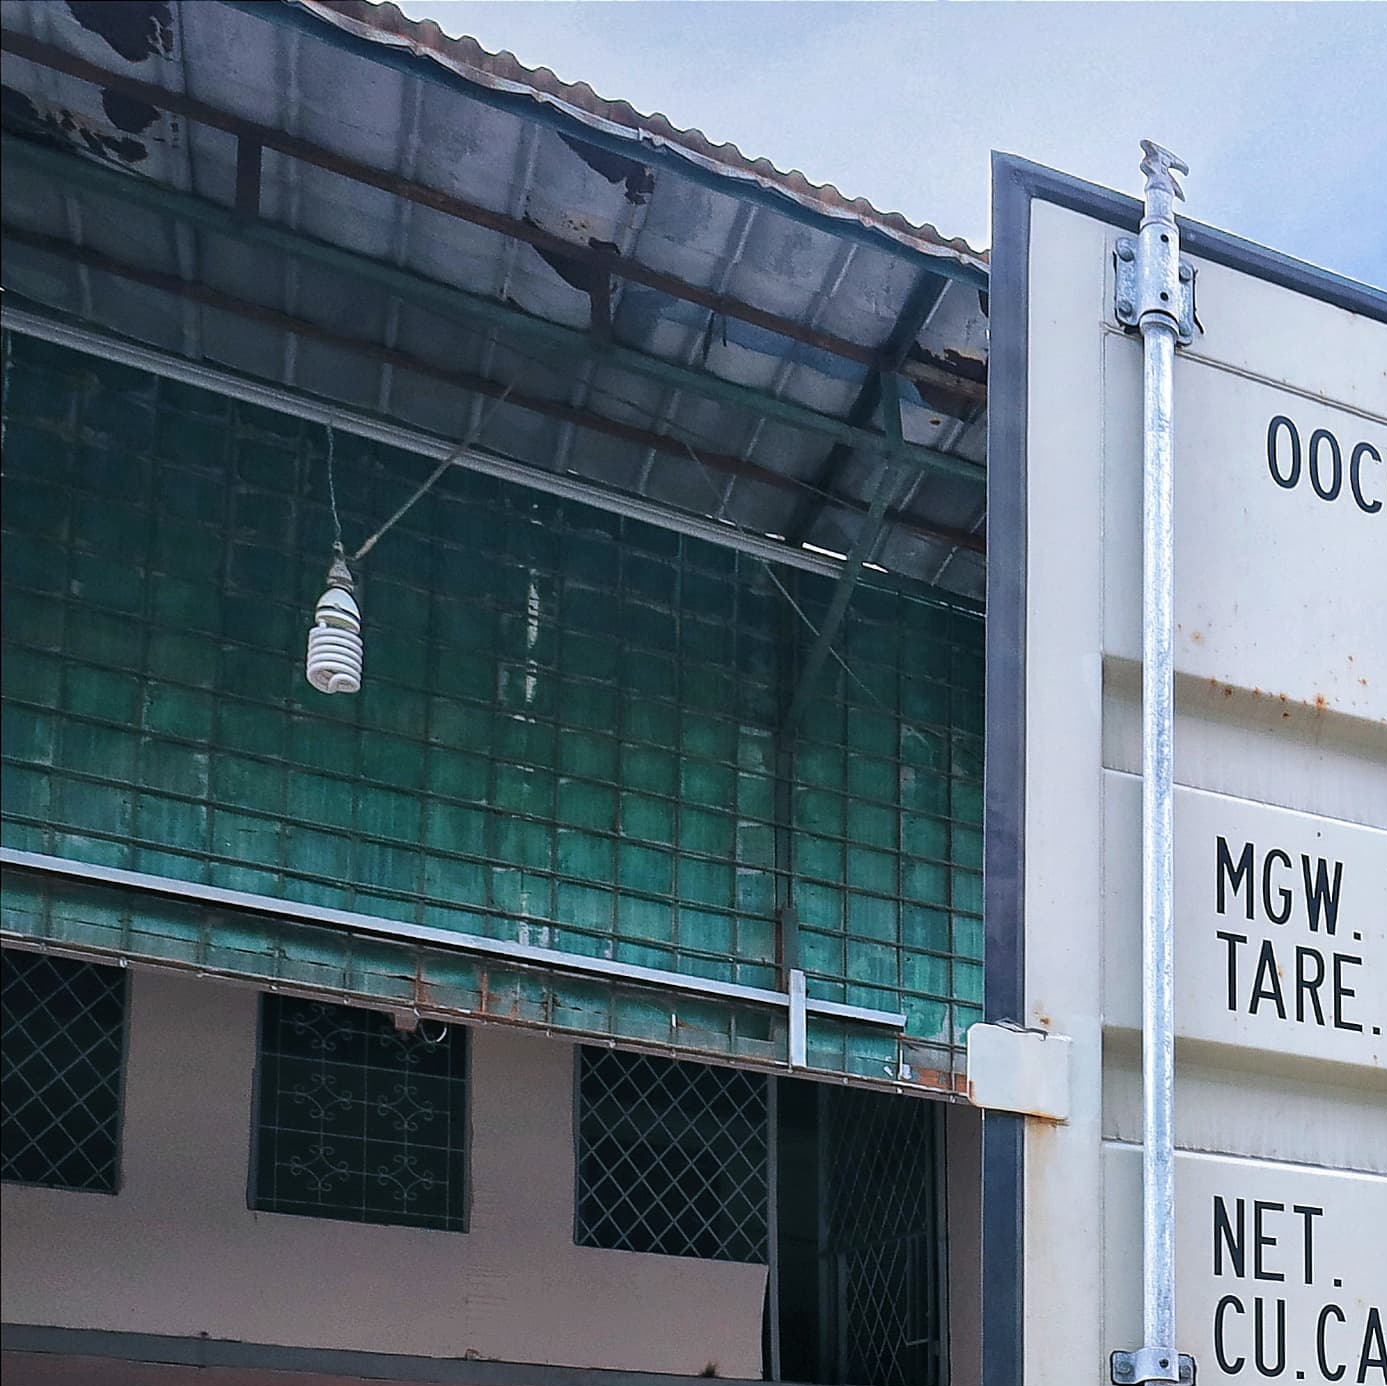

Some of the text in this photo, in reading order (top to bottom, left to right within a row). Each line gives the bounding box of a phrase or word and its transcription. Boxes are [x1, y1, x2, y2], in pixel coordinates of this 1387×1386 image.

[1216, 836, 1362, 941] MGW.
[1216, 931, 1382, 1036] TARE.
[1213, 1195, 1343, 1288] NET.
